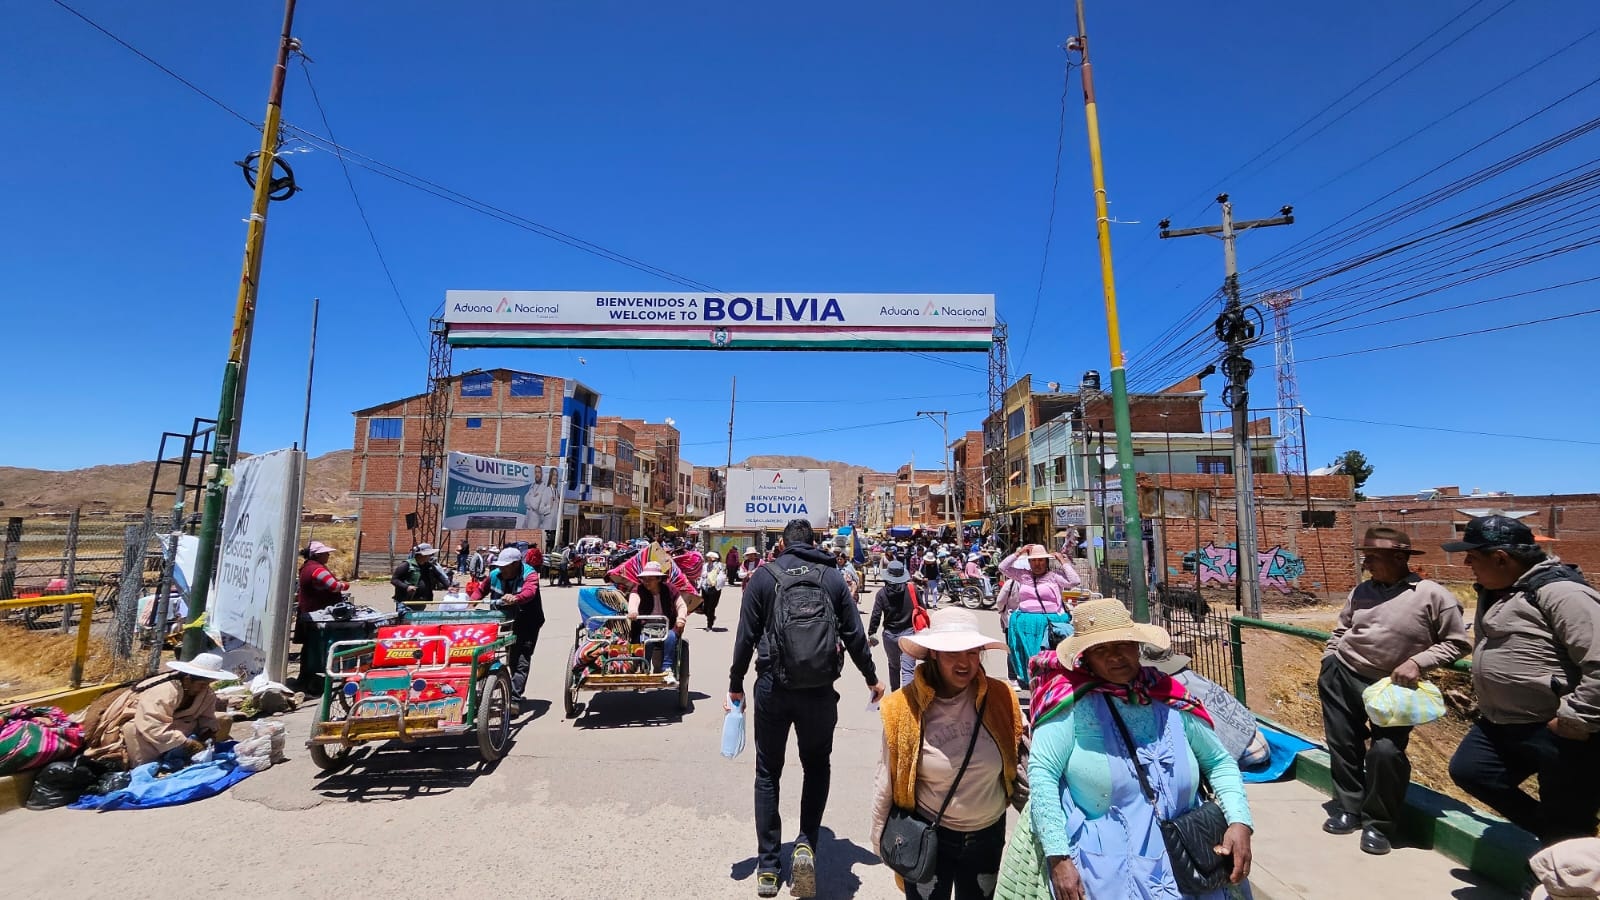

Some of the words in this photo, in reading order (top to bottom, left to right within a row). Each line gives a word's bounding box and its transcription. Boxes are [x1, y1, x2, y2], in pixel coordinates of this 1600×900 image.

[454, 303, 492, 313] Aduana
[514, 303, 559, 313] Nacional
[596, 297, 685, 308] BIENVENIDOS
[688, 298, 698, 308] A
[609, 309, 676, 320] WELCOME
[680, 311, 697, 321] TO
[703, 297, 846, 322] BOLIVIA
[879, 305, 920, 316] Aduana
[941, 306, 987, 317] Nacional
[475, 459, 529, 478] UNITEPC
[454, 491, 492, 506] MEDICINA
[492, 493, 520, 508] HUMANA
[745, 502, 808, 514] BOLIVIA
[236, 512, 251, 536] NO
